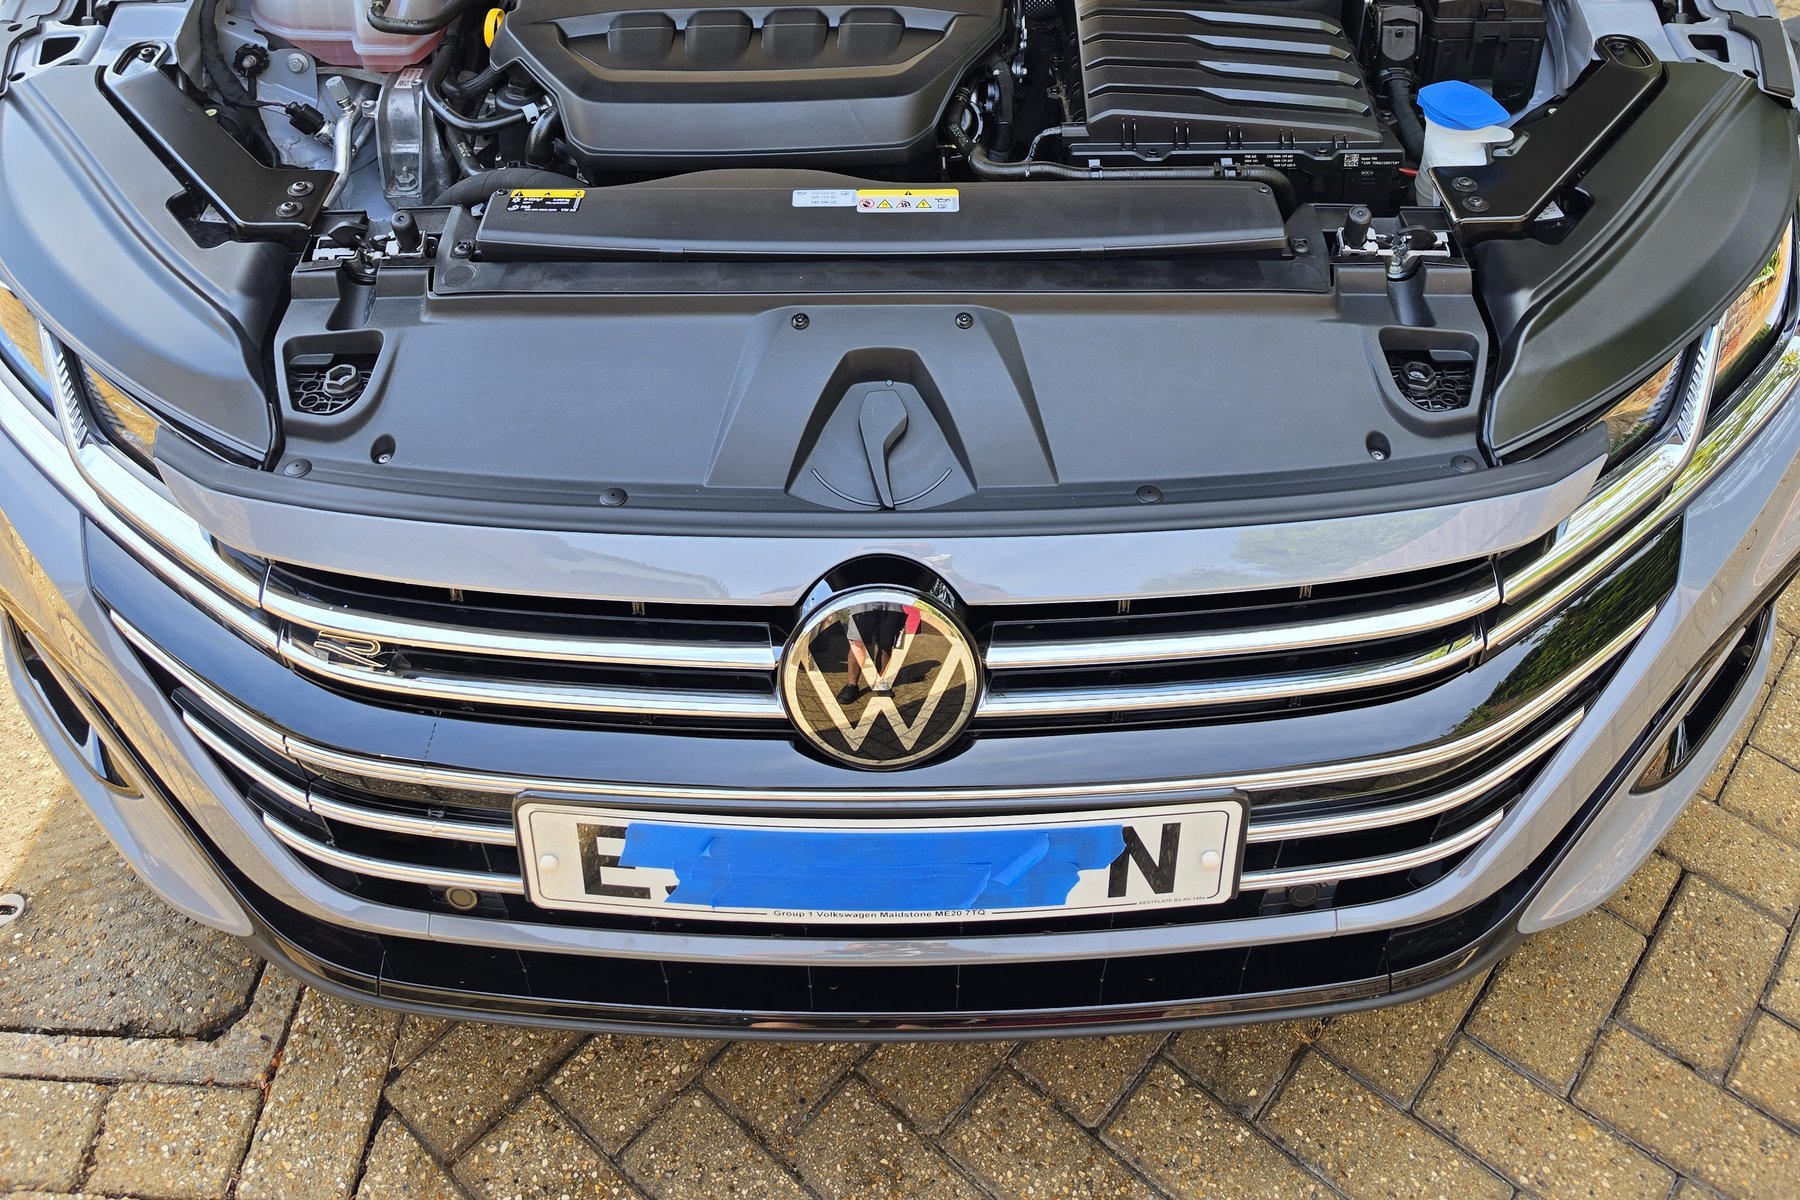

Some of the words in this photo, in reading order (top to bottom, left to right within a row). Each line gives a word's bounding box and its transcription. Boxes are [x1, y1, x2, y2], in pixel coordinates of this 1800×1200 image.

[788, 597, 976, 760] VW
[773, 909, 805, 918] Group
[816, 911, 876, 919] Volkswagen
[879, 910, 932, 918] Maidstone
